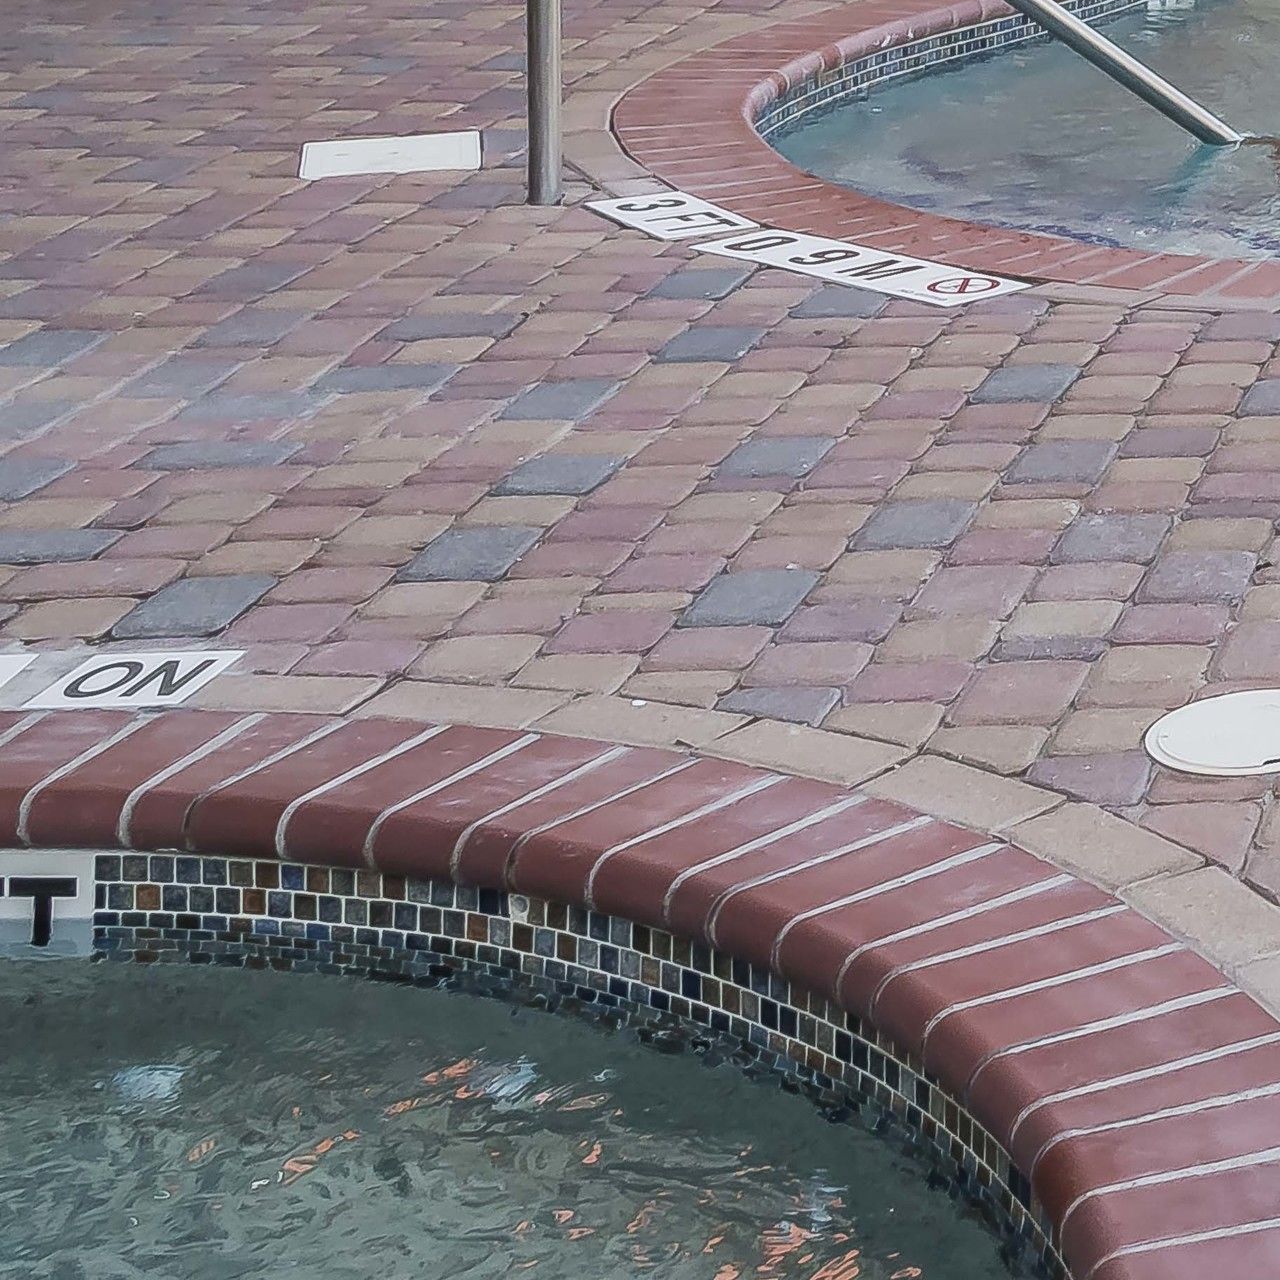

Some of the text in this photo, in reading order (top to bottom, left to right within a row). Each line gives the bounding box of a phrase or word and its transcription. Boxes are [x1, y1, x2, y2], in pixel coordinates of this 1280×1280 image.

[615, 198, 688, 212] 3
[645, 211, 741, 232] FT
[834, 259, 926, 281] M
[0, 877, 78, 947] T
